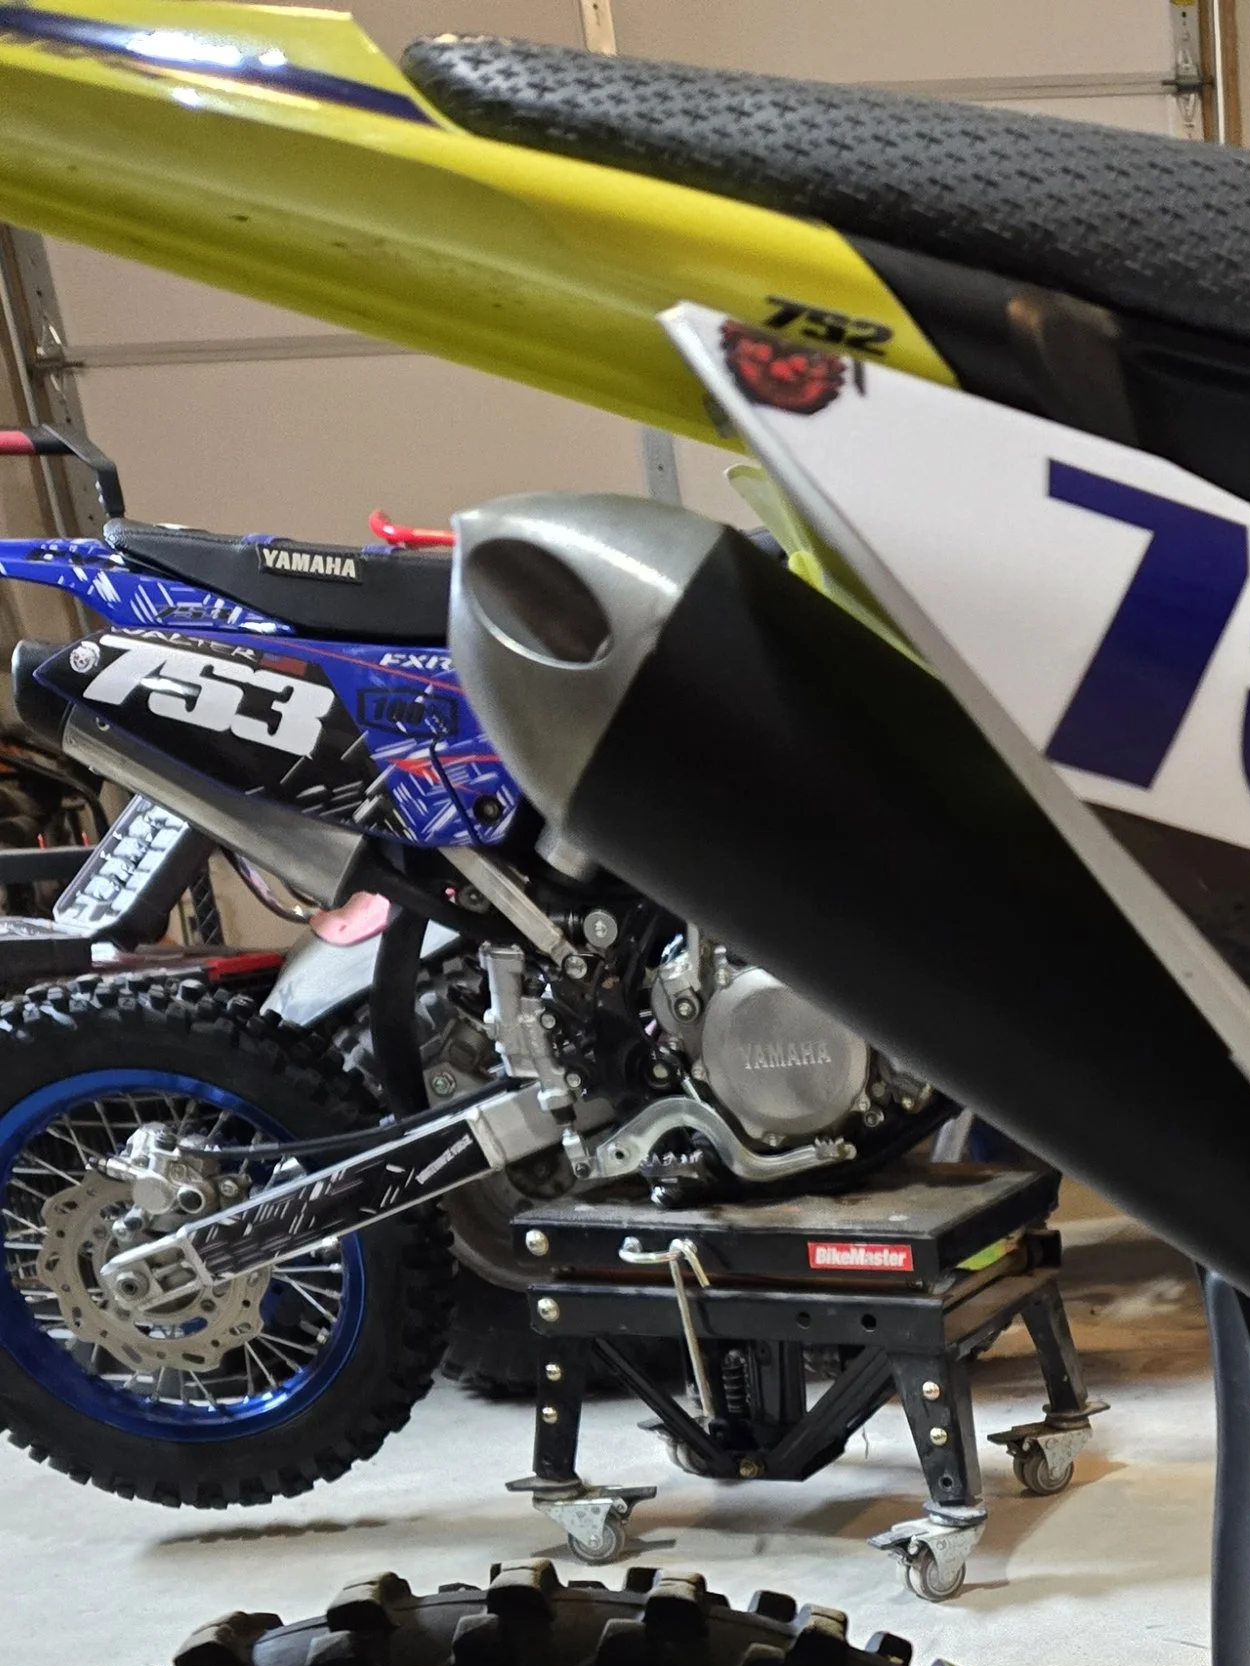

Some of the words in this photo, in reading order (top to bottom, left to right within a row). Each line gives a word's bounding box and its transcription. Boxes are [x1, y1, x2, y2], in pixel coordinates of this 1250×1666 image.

[765, 295, 892, 356] 752
[262, 548, 357, 578] YAMAHA
[379, 653, 453, 671] FXR
[83, 634, 335, 757] 753
[741, 1042, 832, 1070] YAMAHA
[815, 1247, 907, 1266] BikeMaster
